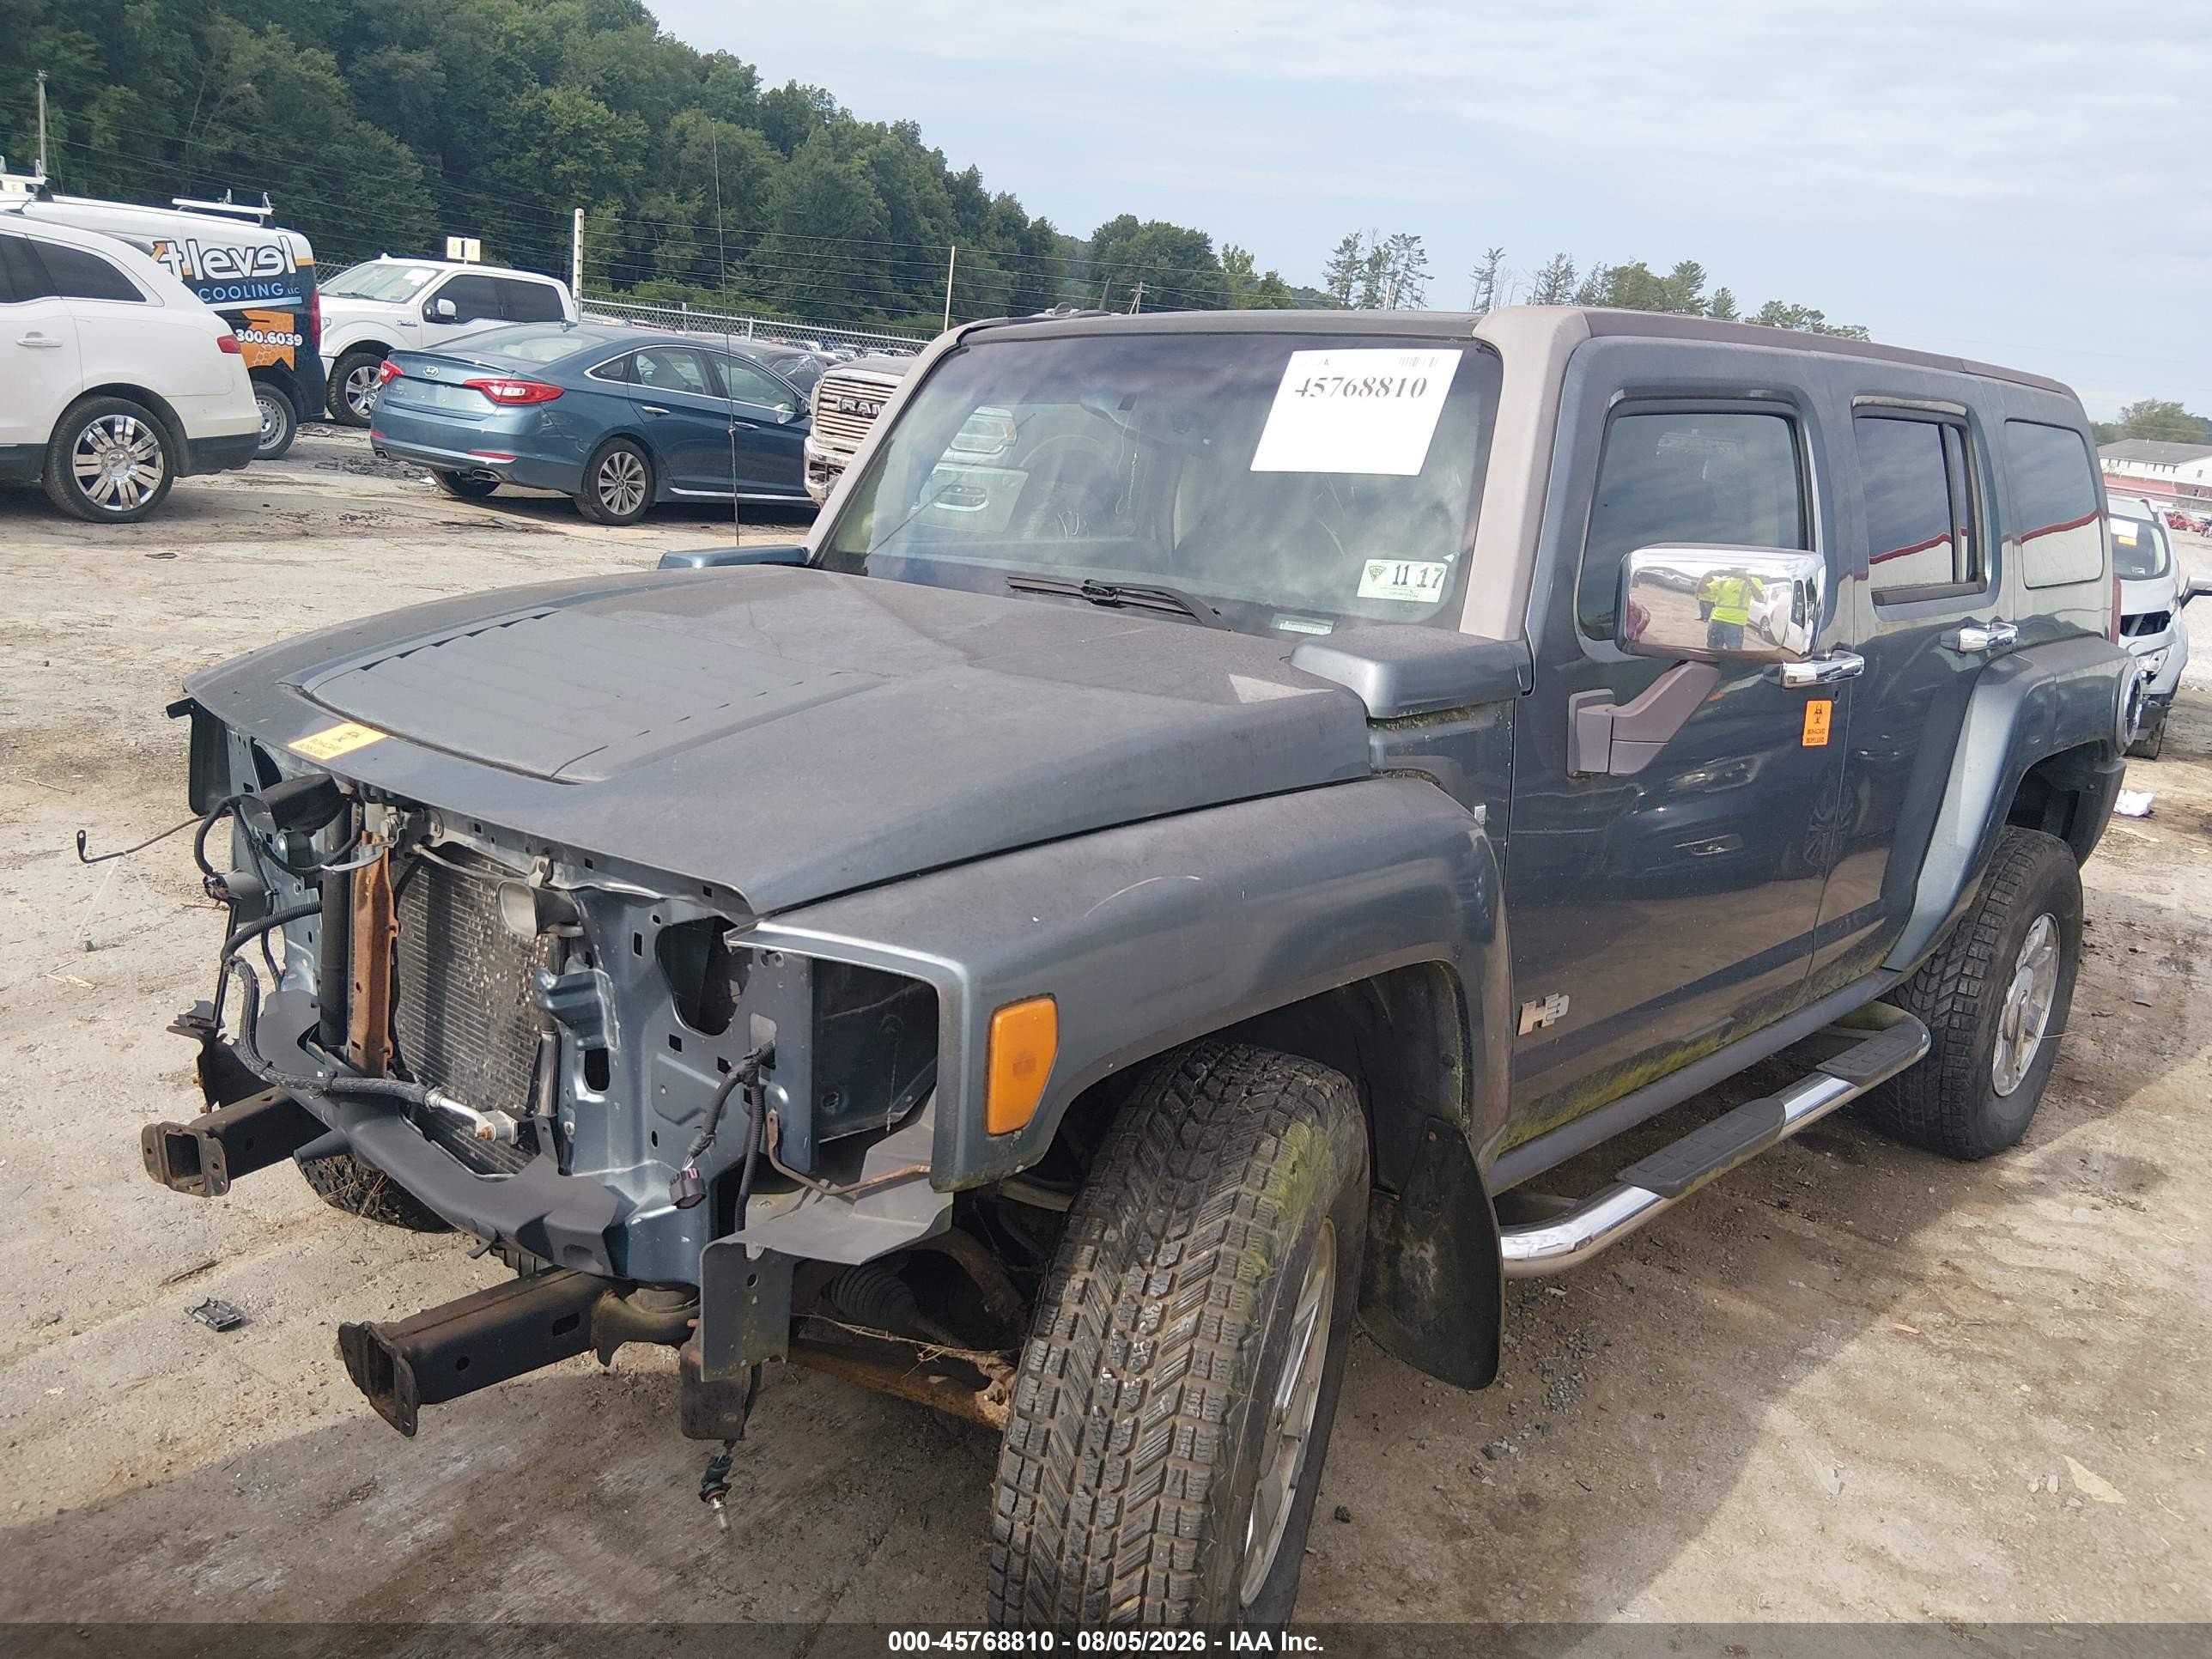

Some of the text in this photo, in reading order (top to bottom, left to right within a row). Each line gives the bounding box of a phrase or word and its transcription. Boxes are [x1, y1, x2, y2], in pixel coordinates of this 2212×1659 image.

[198, 283, 301, 302] COOLING LLC
[235, 329, 303, 347] 300.6039
[1295, 376, 1428, 398] 45768810
[1392, 564, 1445, 589] 11 17
[1517, 992, 1570, 1036] H3
